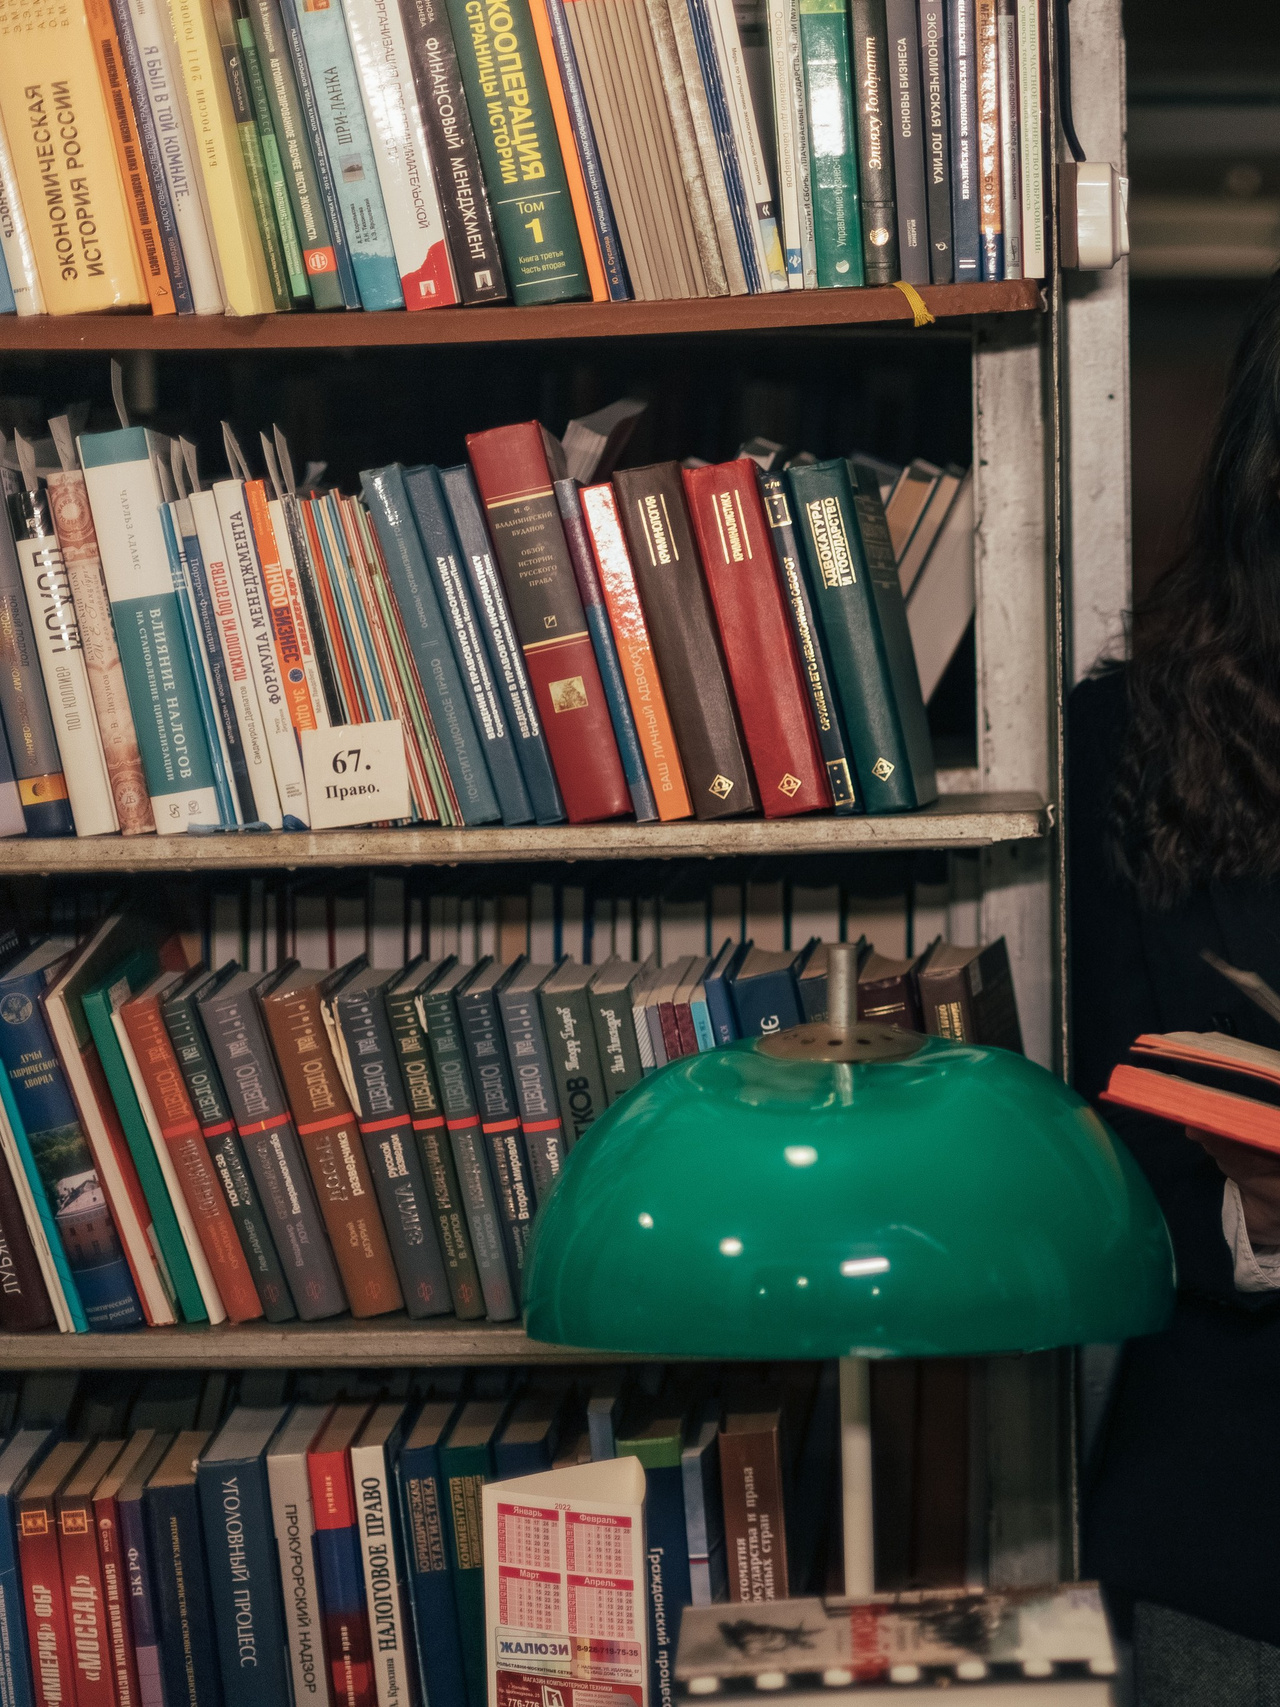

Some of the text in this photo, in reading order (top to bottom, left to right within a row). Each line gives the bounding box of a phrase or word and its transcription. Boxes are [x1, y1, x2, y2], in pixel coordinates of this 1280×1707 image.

[147, 59, 166, 89] БЫЛ
[157, 106, 177, 131] ТОЙ
[187, 49, 217, 167] БАНК РОССИИ 2011
[248, 50, 271, 132] МАСТЕР-КЛАСС
[326, 66, 353, 145] ШРИ-ЛАНКА
[465, 1, 518, 184] СТРАНИЦЫ ИСТОРИИ
[487, 0, 546, 181] КООПЕРАЦИЯ
[771, 11, 798, 188] Основы страхования бакалавров
[863, 37, 885, 169] Элияху Голдратт
[897, 38, 911, 137] ОСНОВЫ БИЗНЕСА
[926, 13, 944, 183] ЭКОНОМИЧЕСКАЯ ЛОГИКА
[1006, 22, 1015, 118] ПРОГНОЗИРОВАНИЕ ФОНДОВЫХ
[270, 59, 317, 240] АВТОМАТИЗИРОВАННОЕ РАБОЧЕЕ МЕСТО ЭКОНОМИСТА
[427, 37, 486, 260] ФИНАНСОВЫЙ МЕНЕДЖМЕНТ
[730, 47, 762, 185] Меры улучшению экологической политики
[958, 60, 969, 199] ЕВРАЗИЙСКАЯ ЭКОНОМИЧЕСКАЯ
[24, 84, 78, 280] ЭКОНОМИЧЕСКАЯ
[51, 81, 104, 277] ИСТОРИЯ РОССИИ
[101, 39, 160, 276] КОМПЛЕКСНЫЙ ЭКОНОМИЧЕСКИЙ АНАЛИЗ ХОЗЯЙСТВЕННОЙ ДЕЯТЕЛЬНОСТИ
[141, 122, 181, 278] Медведев НАЛОГОВЫЕ ПОСЛЕДСТВИЯ
[516, 201, 545, 215] Том
[525, 218, 543, 243] 1
[593, 191, 614, 265] Суслова УПРОЩЕННАЯ
[834, 190, 847, 246] Управление
[1032, 180, 1040, 250] ОБРАЗОВАНИИ:
[519, 250, 564, 265] Книга третья
[520, 260, 566, 275] Часть вторая
[118, 490, 140, 568] ЧАРЛЬЗ АДАМС
[512, 524, 544, 536] БУДАНОВ
[518, 555, 553, 567] ИСТОРИИ
[521, 545, 544, 555] ОБЗОР
[643, 494, 672, 564] КРИМИНОЛОГИЯ
[717, 492, 746, 562] КРИМИНАЛИСТИКА
[806, 500, 842, 588] АДВОКАТУРА
[819, 496, 853, 573] ГОСУДАРСТВО
[230, 510, 281, 704] ФОРМУЛА МЕНЕДЖМЕНТА
[519, 565, 557, 578] РУССКОГО
[529, 577, 552, 587] ПРАВА
[73, 597, 98, 661] БАНКИРСКИЙ
[188, 558, 235, 744] Портрет Финляндии Прошлое настоящее
[264, 561, 300, 663] ИНФОБИЗНЕС
[286, 567, 311, 656] МЕНЕДЖЕР-КОУЧ
[436, 557, 495, 739] ВВЕДЕНИЕ ПРАВОВУЮ ИНФОРМАТИКУ
[446, 555, 505, 737] Справочные КонсультантПлюс
[472, 556, 530, 738] ВВЕДЕНИЕ ПРАВОВУЮ ИНФОРМАТИКУ
[482, 554, 539, 736] Справочные КонсультантПлюс
[783, 557, 832, 730] ОРУЖИЕ ЕГО НЕЗАКОННЫЙ ОБОРОТ
[55, 666, 81, 731] ПОЛ КОЛЛИЕР
[102, 674, 116, 714] Лизунов
[139, 628, 174, 781] СТАНОВЛЕНИЕ ЦИВИЛИЗАЦИИ
[150, 608, 192, 778] ВЛИЯНИЕ НАЛОГОВ
[240, 686, 262, 765] Саидмурод Давлатов
[431, 658, 478, 803] КОНСТИТУЦИОННОЕ ПРАВО
[628, 644, 673, 791] ВАШ ЛИЧНЫЙ АДВОКАТ
[325, 782, 380, 800] Право.
[331, 749, 371, 774] 67.
[19, 1049, 43, 1067] ДУМЫ
[24, 1071, 54, 1089] ДВОРЦА
[301, 1057, 334, 1109] ДЕЛО
[361, 1060, 394, 1114] ДЕЛО
[220, 1167, 240, 1207] погоня
[270, 1133, 301, 1214] Генерального штаба
[337, 1131, 365, 1196] разведчика
[379, 1142, 400, 1178] русской
[387, 1134, 409, 1176] разведки
[504, 1136, 523, 1181] мировой
[440, 1215, 455, 1257] АНТОНОВ
[450, 1213, 464, 1248] КАРПОВ
[511, 1182, 531, 1219] Второй
[404, 1478, 431, 1572] ЮРИДИЧЕСКАЯ
[417, 1476, 447, 1570] СТАТИСТИКА
[449, 1477, 471, 1568] КОММЕНТАРИЙ
[514, 1506, 617, 1525] Январь Февраль
[743, 1467, 758, 1507] права
[127, 1548, 143, 1596] БК РФ
[222, 1477, 257, 1667] УГОЛОВНЫЙ ПРОЦЕСС
[361, 1478, 397, 1651] НАЛОГОВОЕ ПРАВО
[757, 1514, 774, 1552] стран
[31, 1585, 53, 1617] ФБР
[104, 1563, 126, 1666] СБОРНИК ДОЛЖНОСТНЫХ
[285, 1504, 316, 1693] ПРОКУРОРСКИЙ НАДЗОР
[520, 1569, 616, 1587] Март Апрель
[647, 1547, 670, 1645] Гражданский
[70, 1575, 104, 1681] «МОССАД»
[500, 1641, 569, 1656] ЖАЛЮЗИ
[385, 1658, 399, 1697] Крохина
